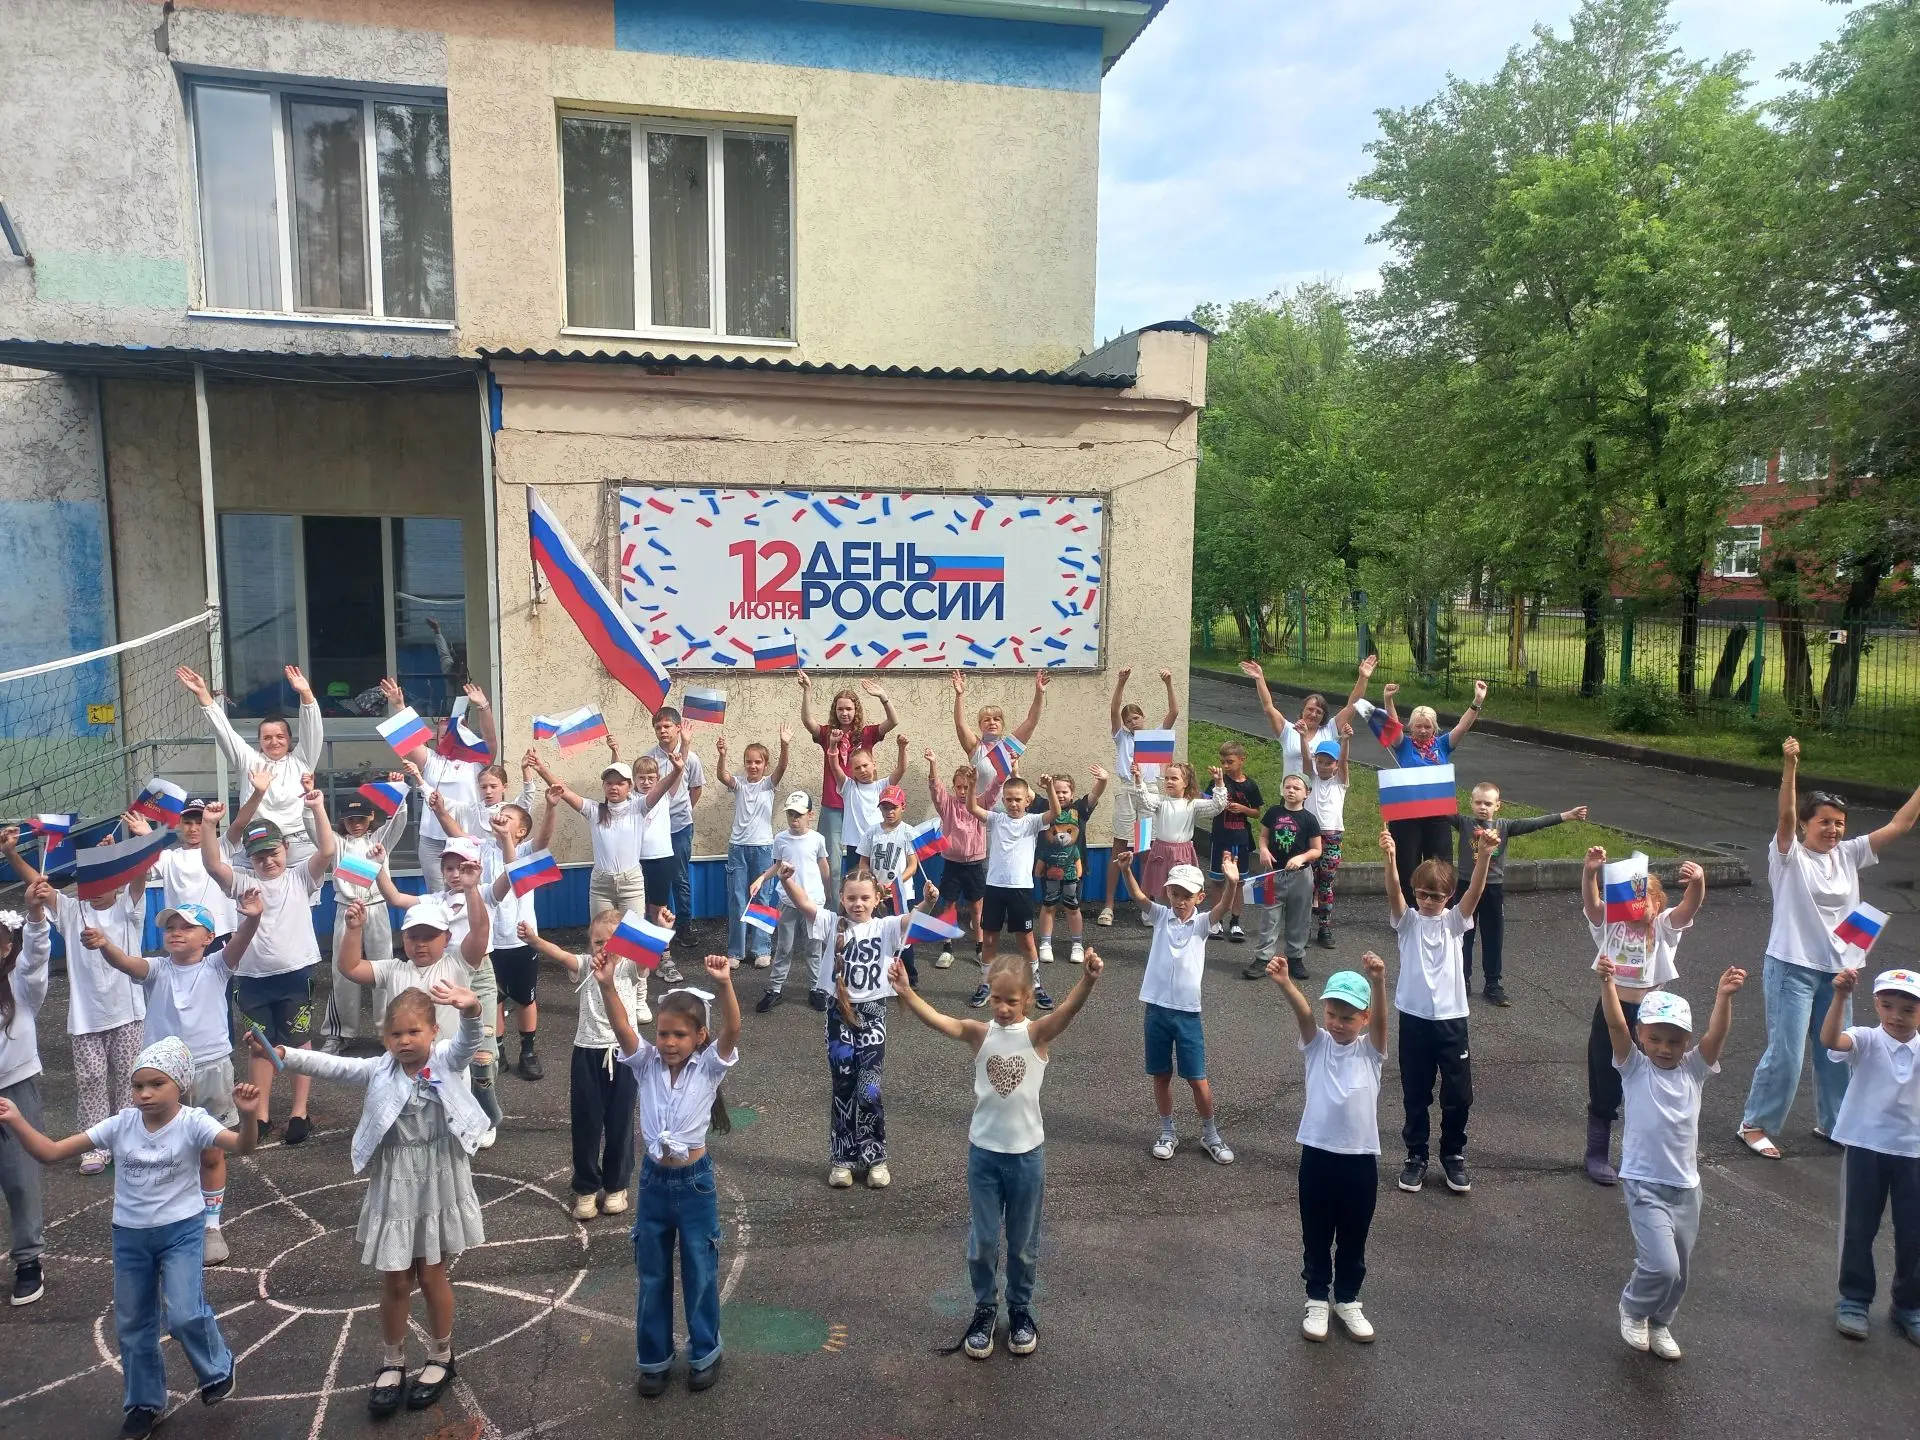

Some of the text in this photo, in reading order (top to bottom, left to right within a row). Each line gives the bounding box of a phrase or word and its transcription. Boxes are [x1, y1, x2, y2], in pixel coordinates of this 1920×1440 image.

[729, 540, 802, 602] 12
[801, 541, 937, 581] ДЕНЬ
[729, 602, 802, 620] ИЮНЯ
[801, 581, 1004, 621] РОССИИ
